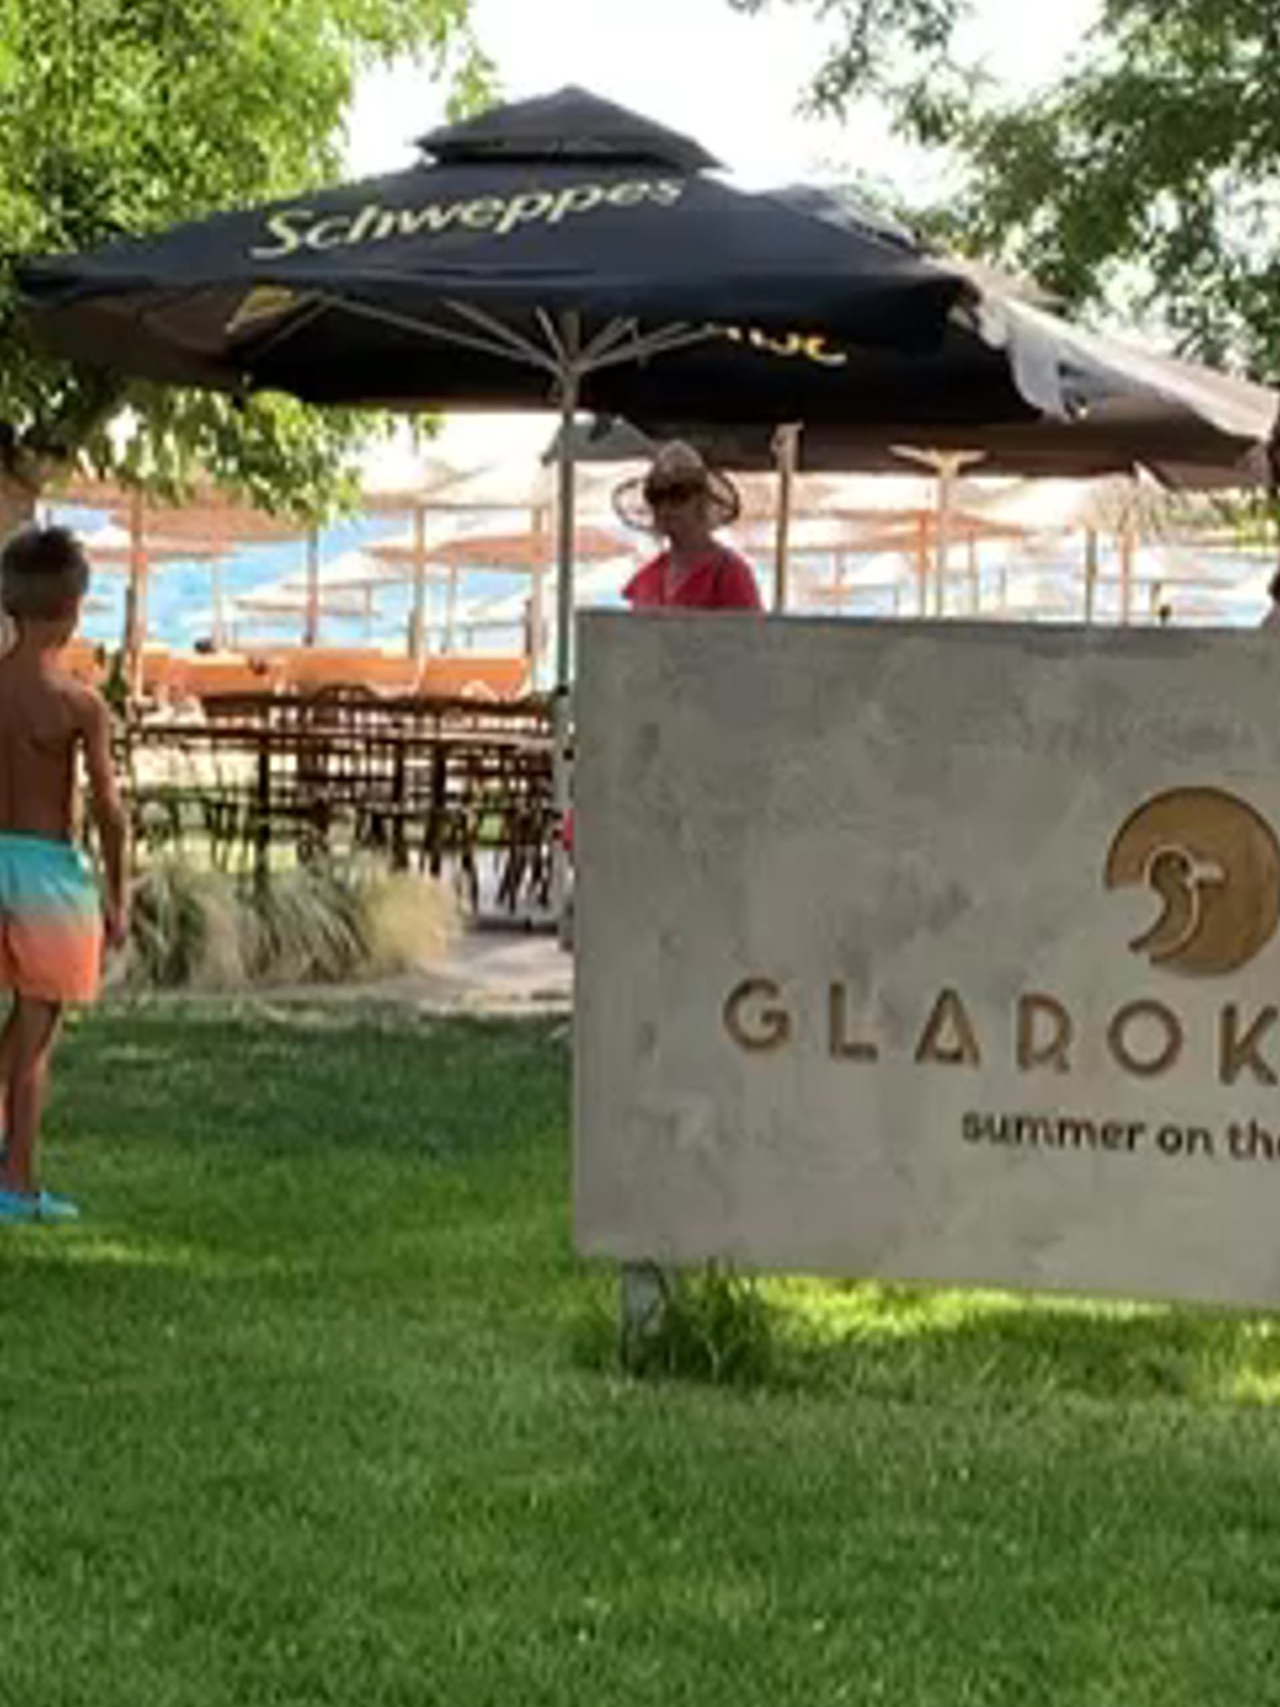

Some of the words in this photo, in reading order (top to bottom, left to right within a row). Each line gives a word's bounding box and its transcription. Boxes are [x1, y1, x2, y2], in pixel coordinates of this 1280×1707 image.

[250, 178, 687, 259] Schweppes
[961, 1110, 1145, 1152] summer
[1156, 1123, 1216, 1157] on
